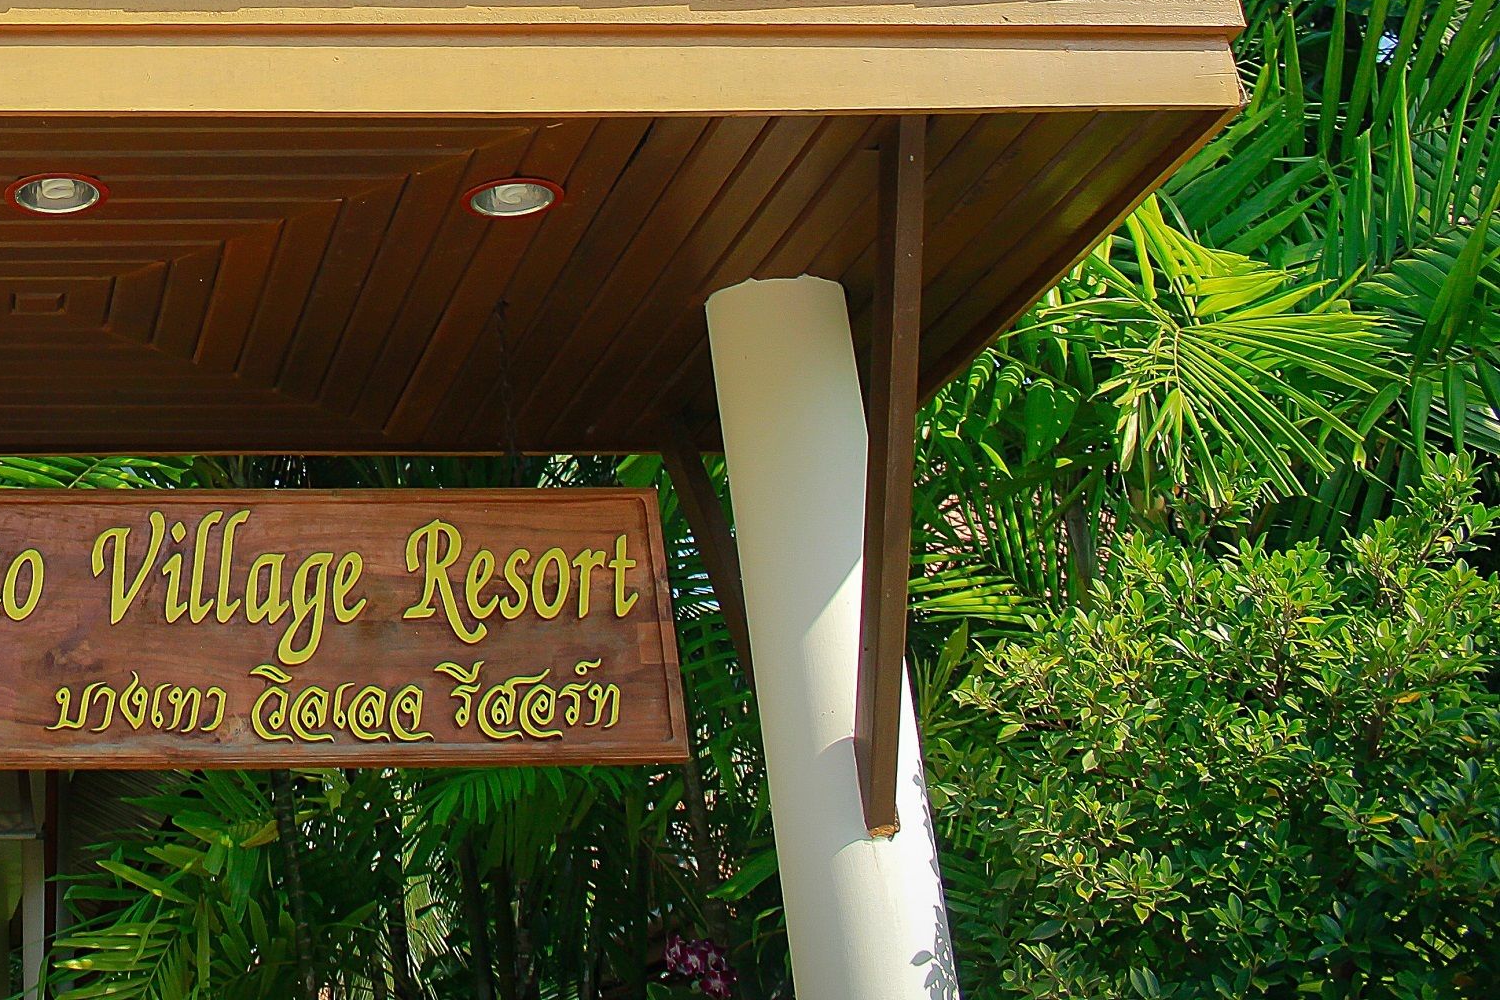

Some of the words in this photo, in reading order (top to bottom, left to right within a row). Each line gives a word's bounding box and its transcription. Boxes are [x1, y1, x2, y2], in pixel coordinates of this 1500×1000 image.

[91, 510, 367, 665] Village
[402, 518, 639, 645] Resort
[46, 671, 227, 731] บางเทา
[250, 664, 435, 742] วิลเลจ
[434, 659, 621, 739] รีสอร์ท
